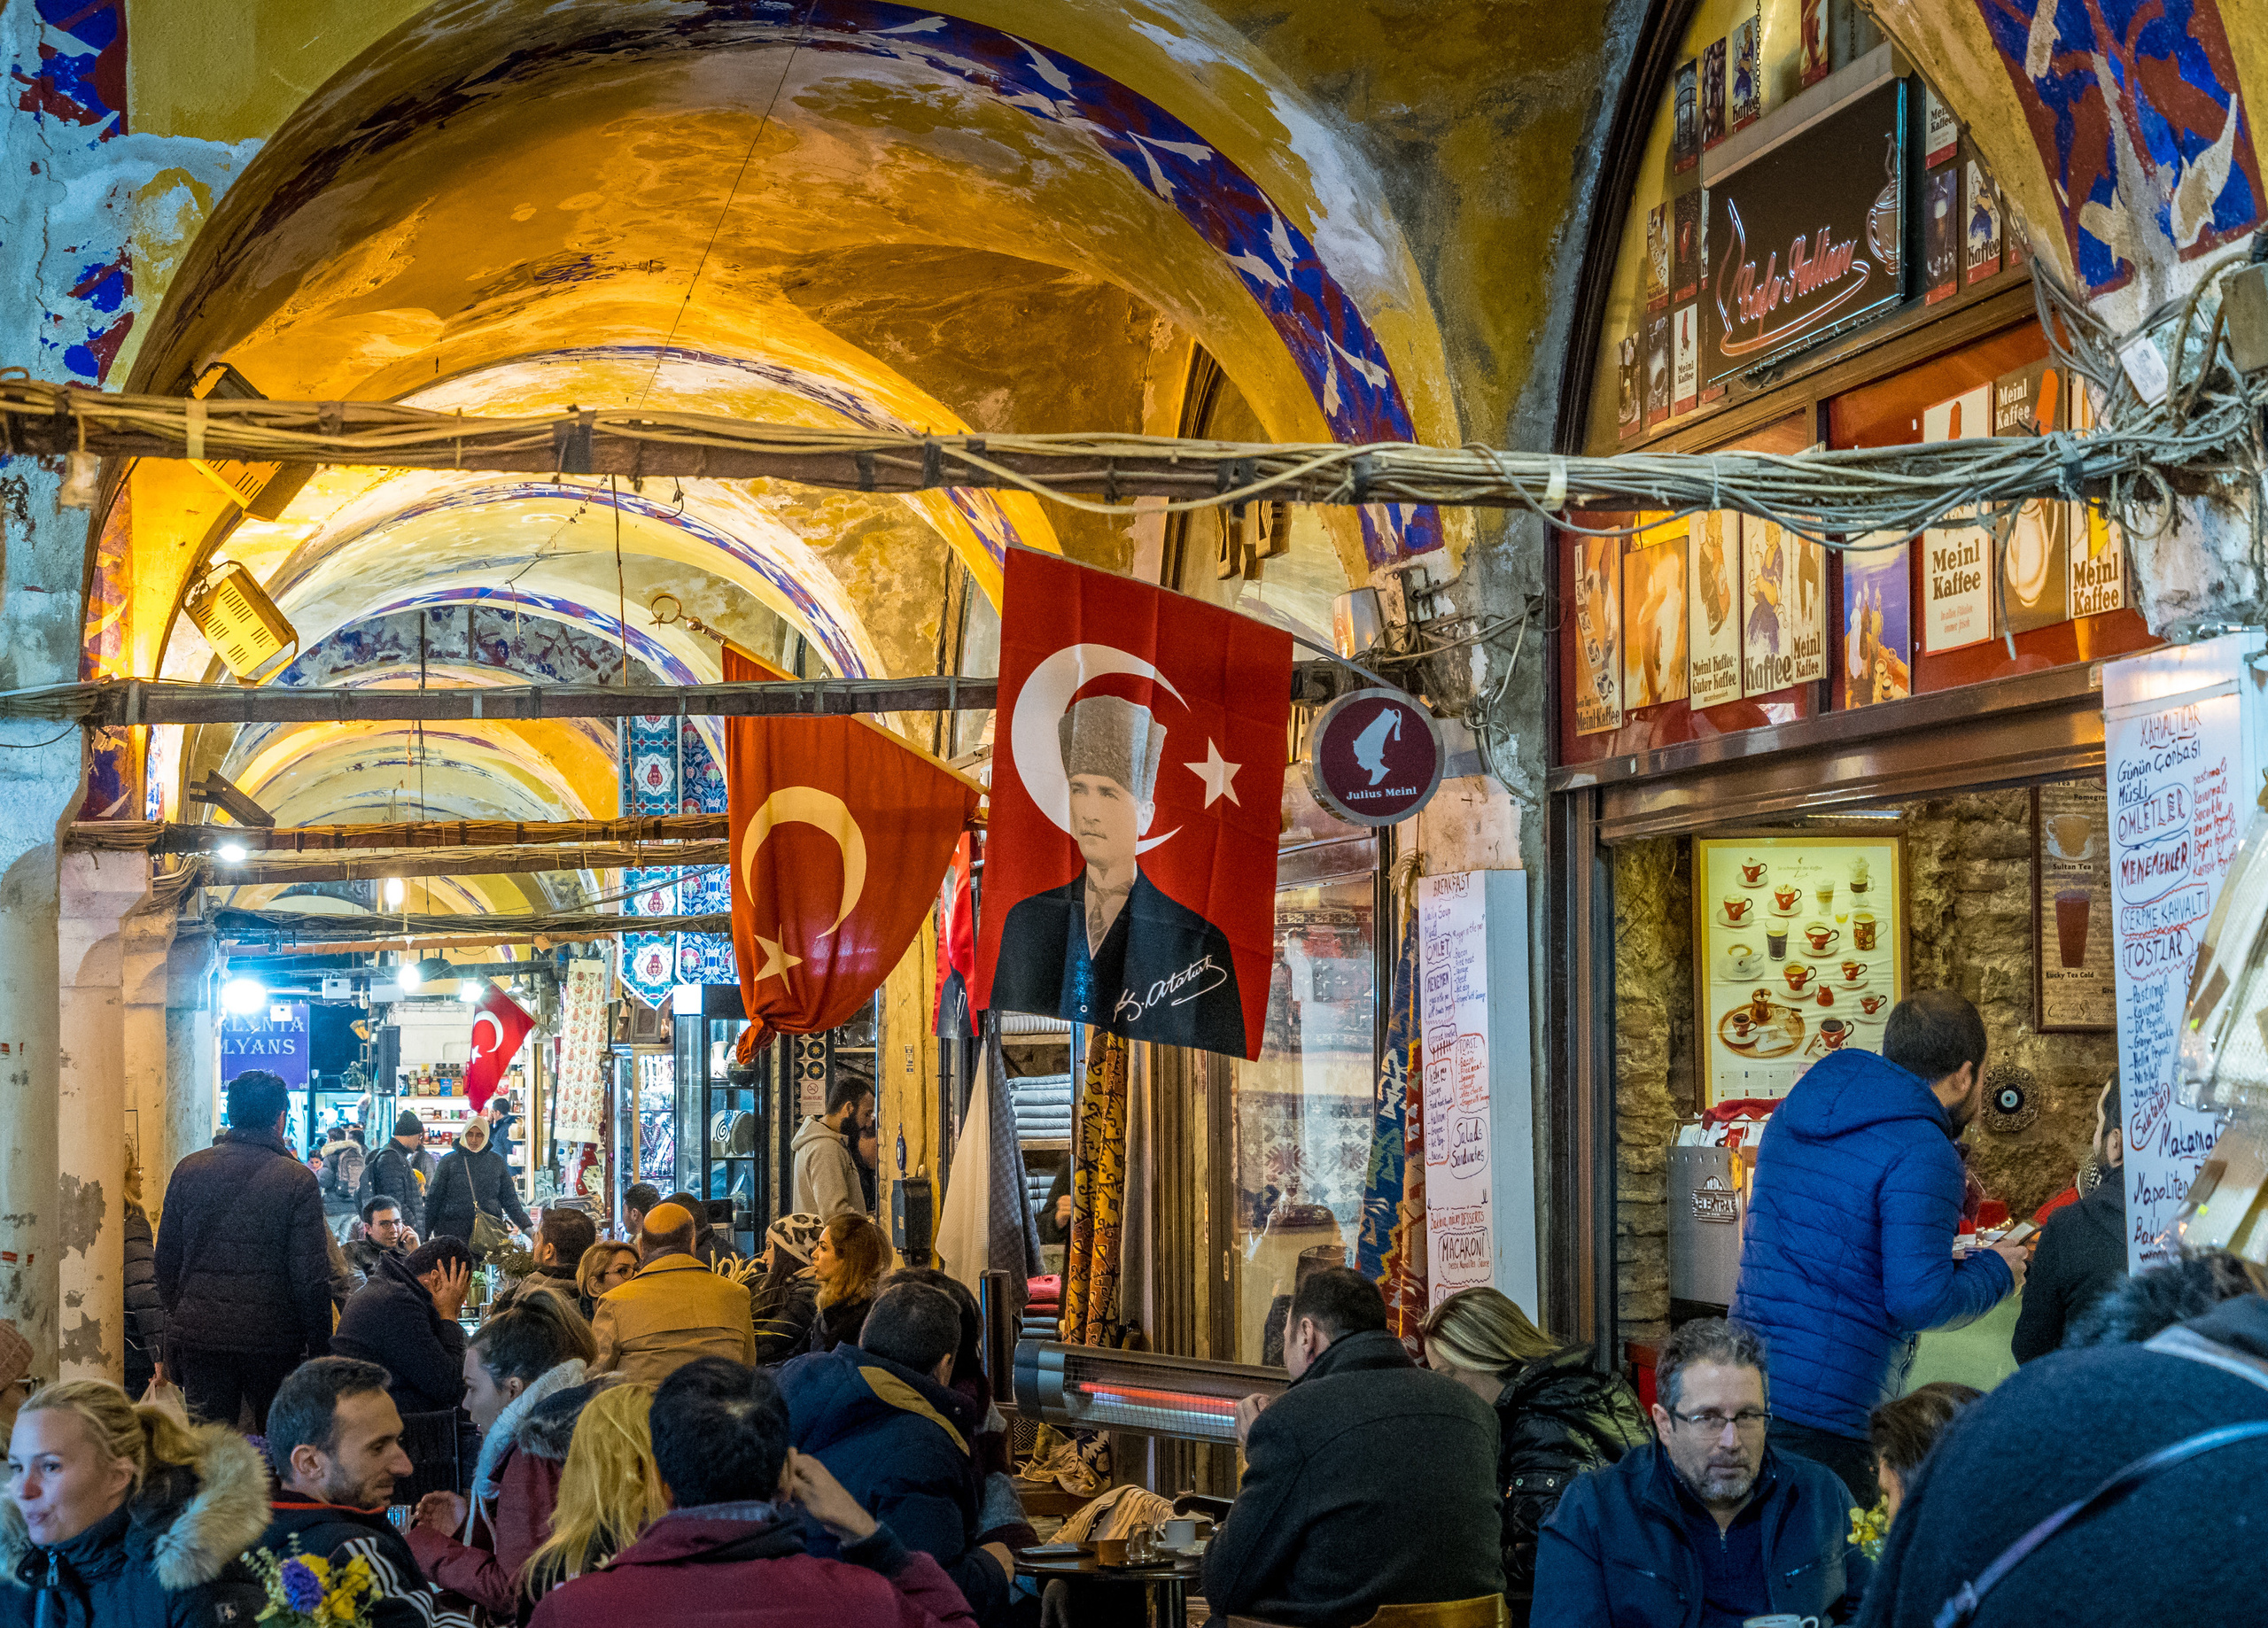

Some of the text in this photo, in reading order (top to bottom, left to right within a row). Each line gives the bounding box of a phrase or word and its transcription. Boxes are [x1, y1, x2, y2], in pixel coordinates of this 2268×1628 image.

[1968, 238, 2000, 266] Kaffee
[1678, 360, 1694, 374] Meinl
[1678, 372, 1694, 384] Kaffee
[1999, 378, 2028, 407] Meinl
[1996, 404, 2031, 430] Kaffee
[1932, 539, 1981, 574] Meinl
[1932, 570, 1982, 601] Kaffee
[2073, 553, 2119, 590] Meinl
[2073, 585, 2119, 616] Kaffee
[1793, 632, 1821, 660] Meinl
[1692, 658, 1712, 677] Meinl
[1745, 654, 1792, 692] Kaffee
[1796, 659, 1819, 679] Kaffee
[1692, 671, 1737, 694] Guter Kaffee
[1576, 705, 1620, 732] Meinl Kaffee
[2117, 740, 2202, 783] Günün Çorbası
[1346, 787, 1418, 801] Julius Meinl
[2118, 788, 2186, 841] OMLETLER
[1433, 872, 1471, 896] BREAKFAST
[2123, 890, 2208, 932] SERPME KAHVALTI
[1427, 938, 1449, 961] OMLET
[2125, 930, 2183, 968] TOSTLAR
[221, 1037, 296, 1055] LYANS
[1454, 1120, 1483, 1148] Salads
[1461, 1211, 1485, 1227] DESSERTS
